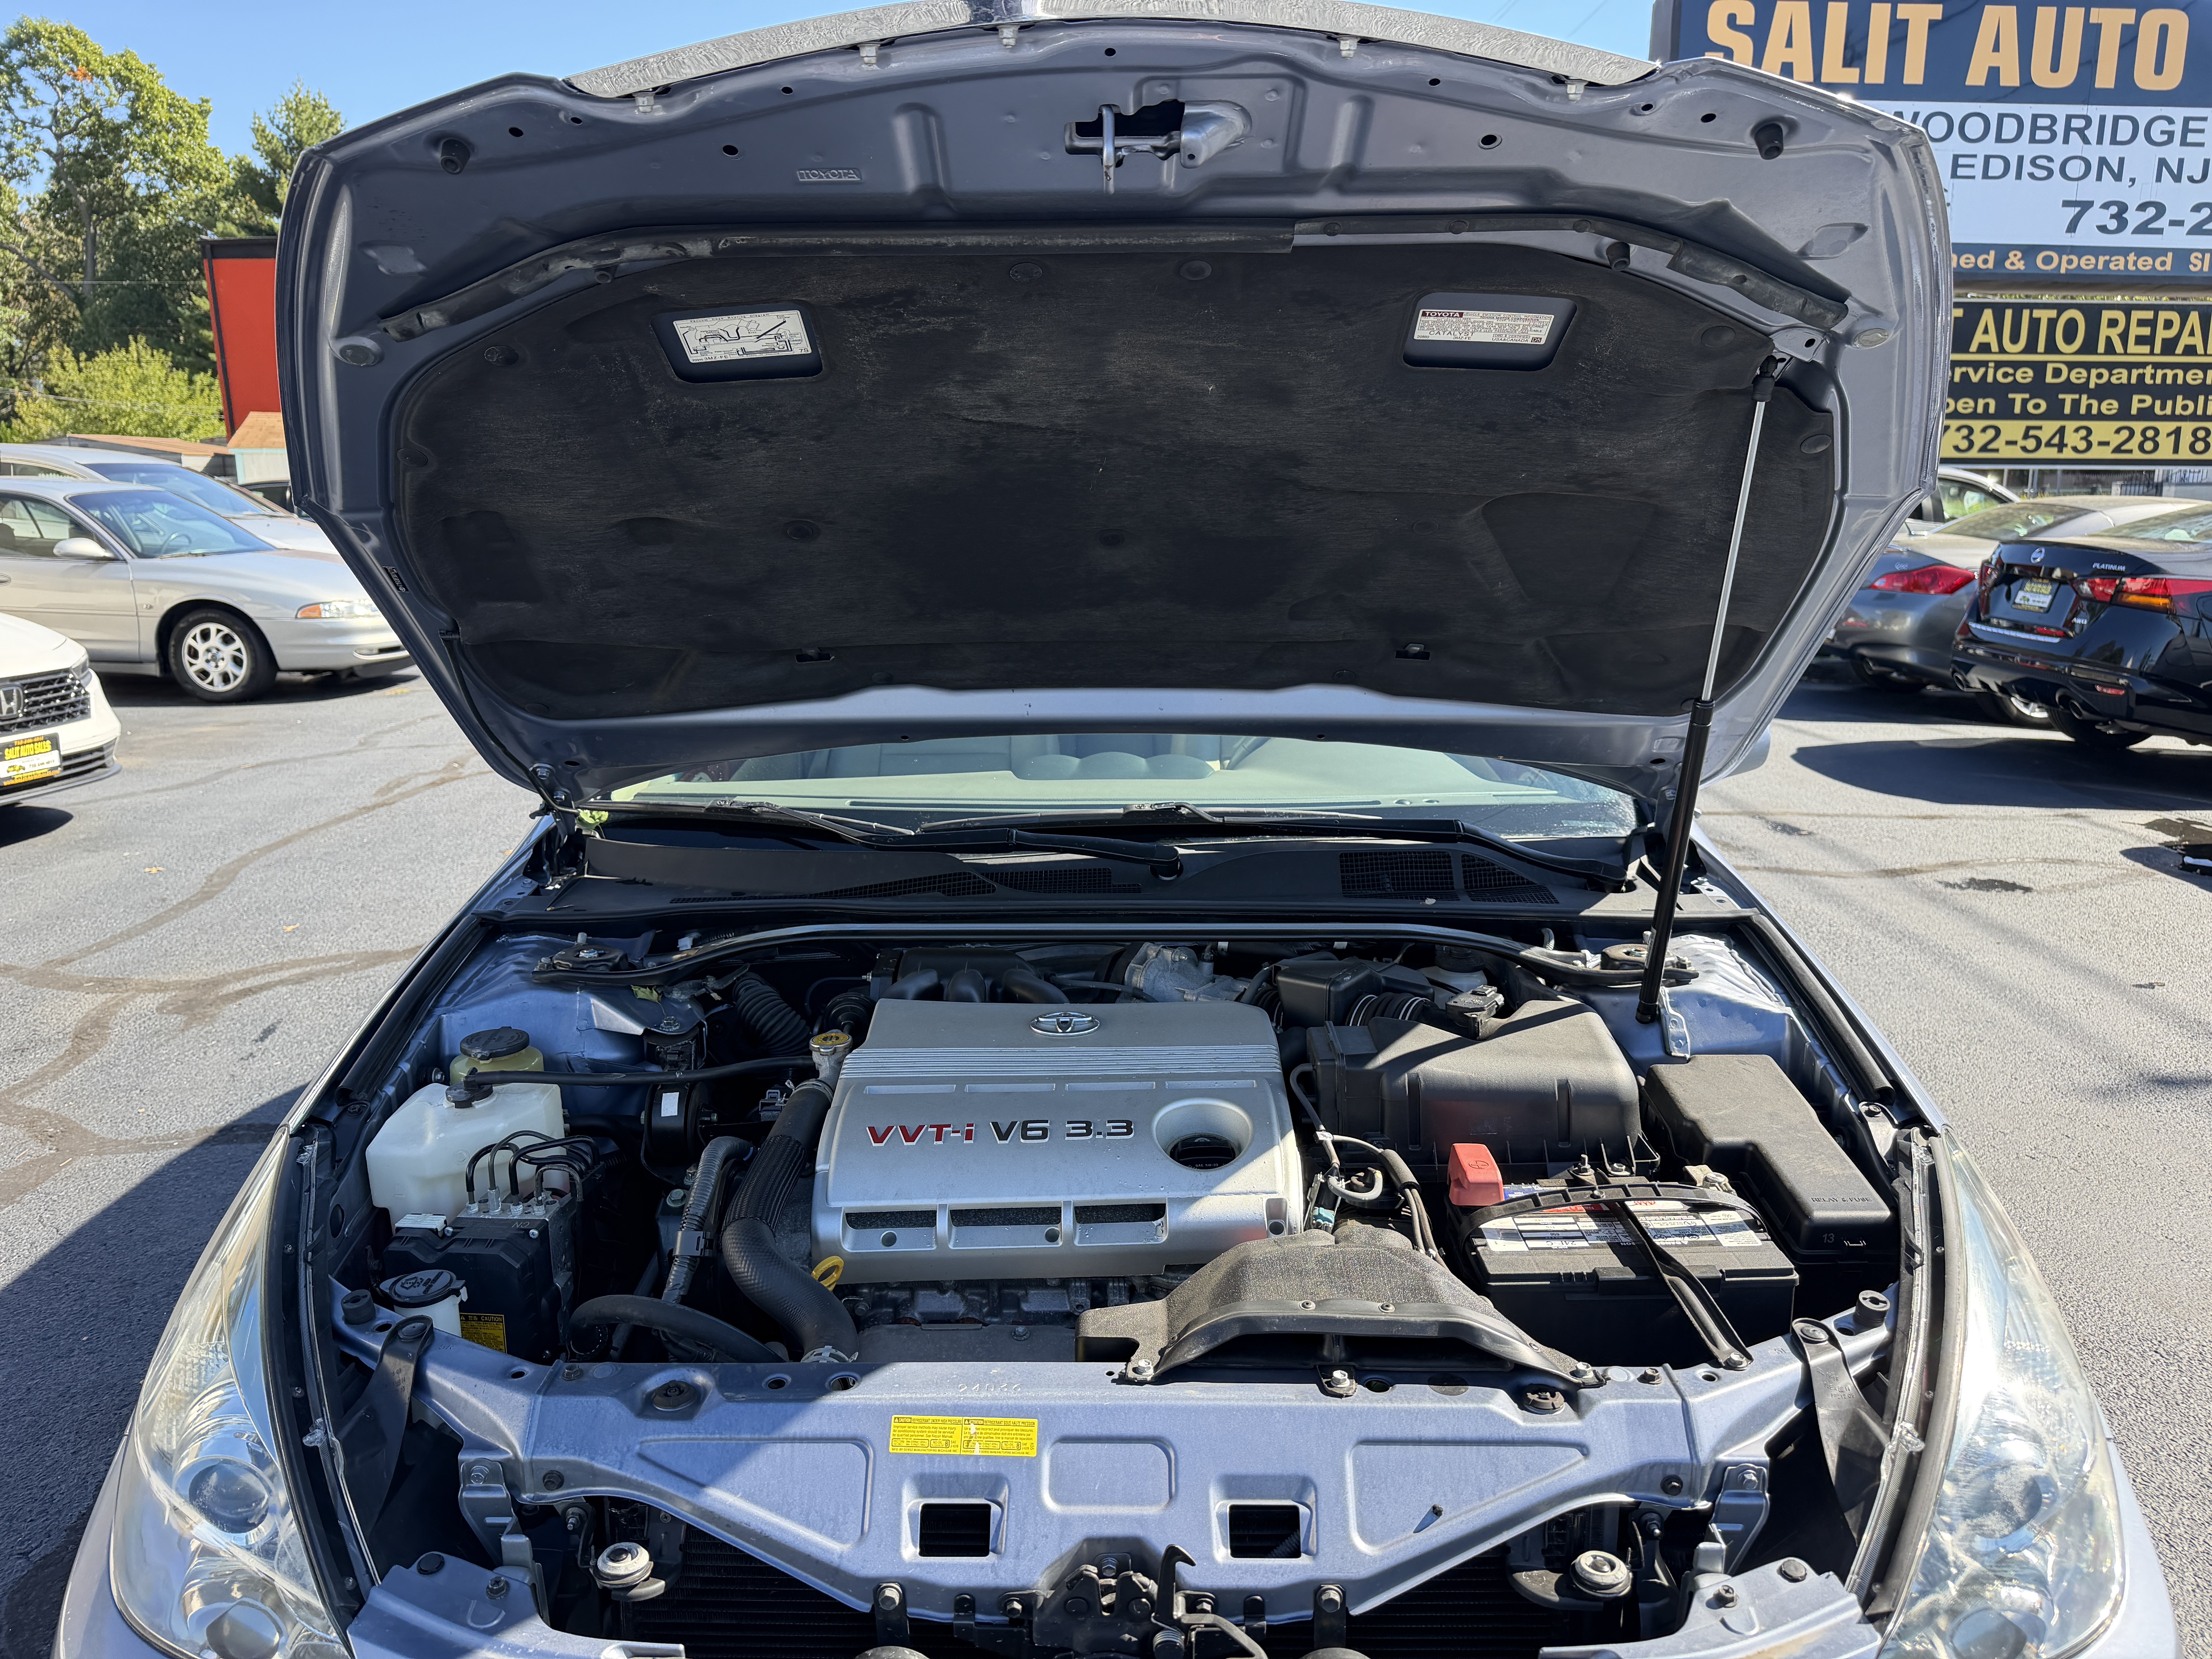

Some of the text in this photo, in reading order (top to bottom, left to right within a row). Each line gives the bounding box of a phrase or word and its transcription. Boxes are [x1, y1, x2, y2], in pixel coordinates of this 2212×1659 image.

[1705, 0, 2190, 91] SALIT AUTO
[799, 170, 858, 179] TOYOTA
[1950, 154, 2210, 187] EDISON, NJ
[2004, 250, 2025, 270] &
[2036, 251, 2172, 273] Operated
[1969, 308, 2086, 354] AUTO
[1949, 362, 2034, 383] rvice
[2008, 393, 2047, 414] To
[2058, 394, 2119, 416] The
[2093, 563, 2126, 572] PLATINUM
[20, 743, 34, 757] AUTO
[34, 740, 52, 754] SALES
[866, 1120, 1134, 1146] VVT-i V6 3.3
[1822, 1233, 1835, 1243] 13
